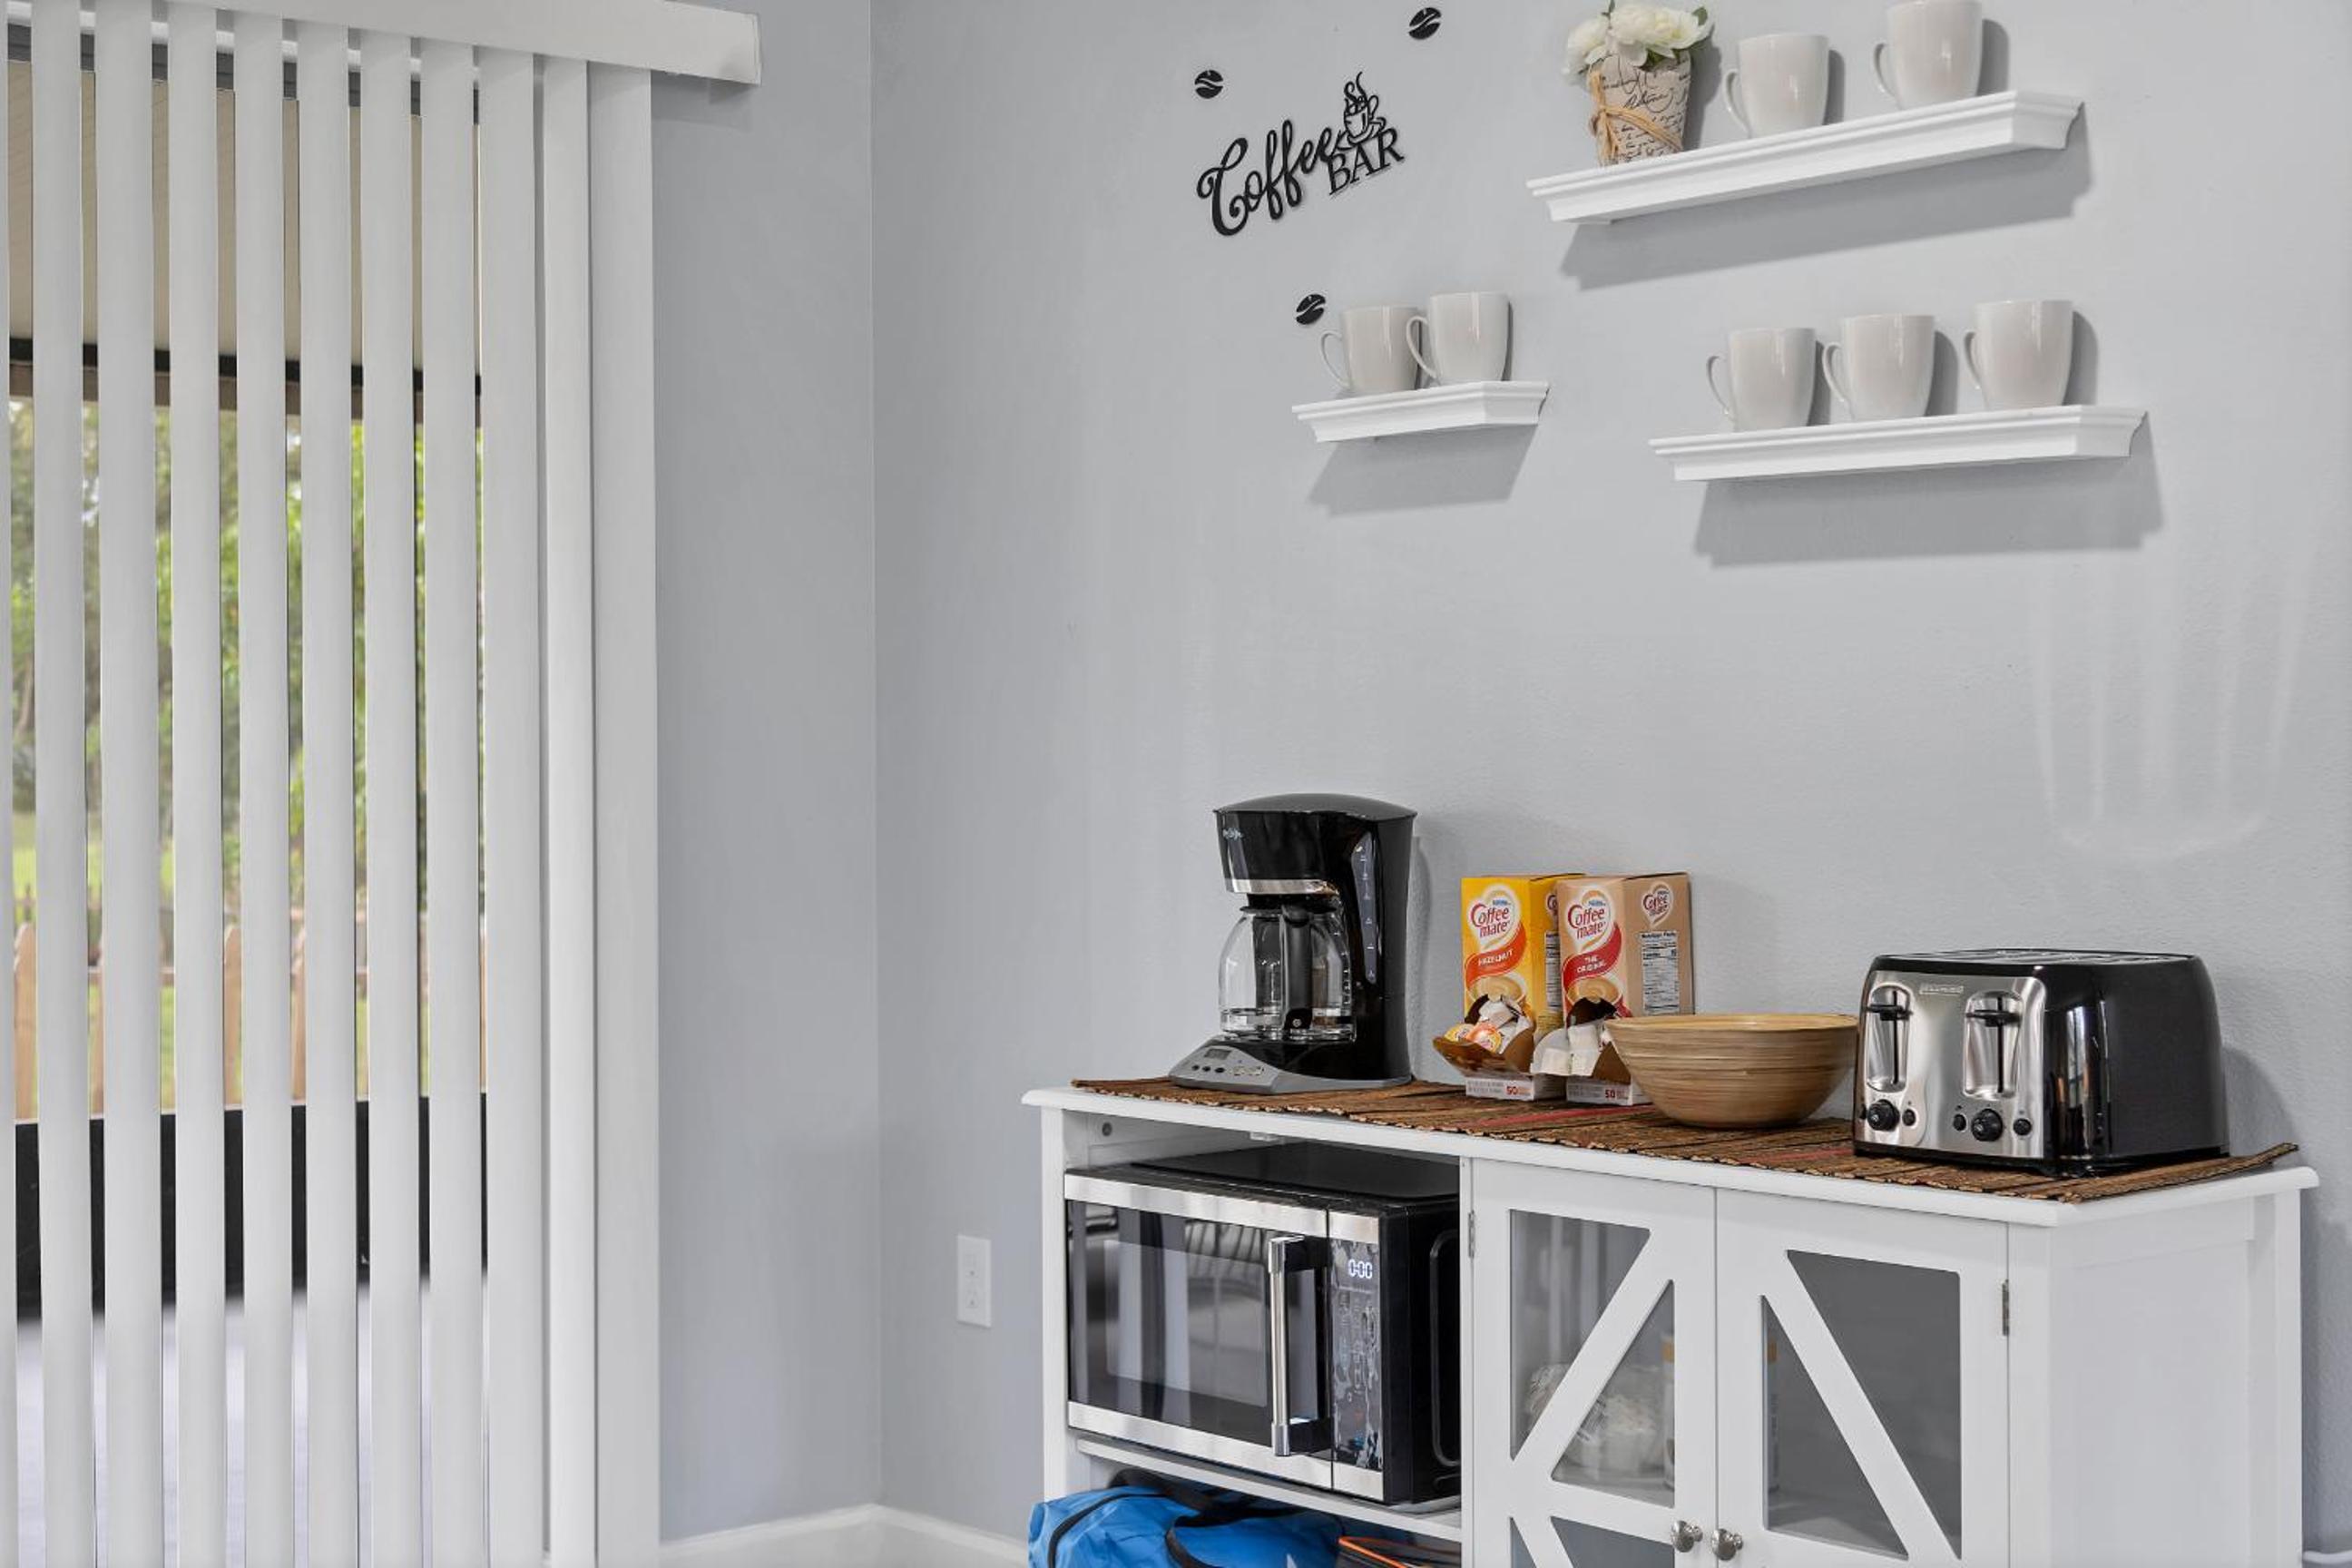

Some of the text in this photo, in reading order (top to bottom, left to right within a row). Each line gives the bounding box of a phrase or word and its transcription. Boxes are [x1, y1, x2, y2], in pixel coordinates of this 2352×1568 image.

[1328, 127, 1405, 195] BAR
[1196, 119, 1339, 237] Coffee
[1471, 903, 1510, 927] Coffee
[1567, 904, 1605, 928] Coffee
[1479, 921, 1508, 938] mate
[1576, 921, 1603, 939] mate
[1605, 1089, 1616, 1098] 50
